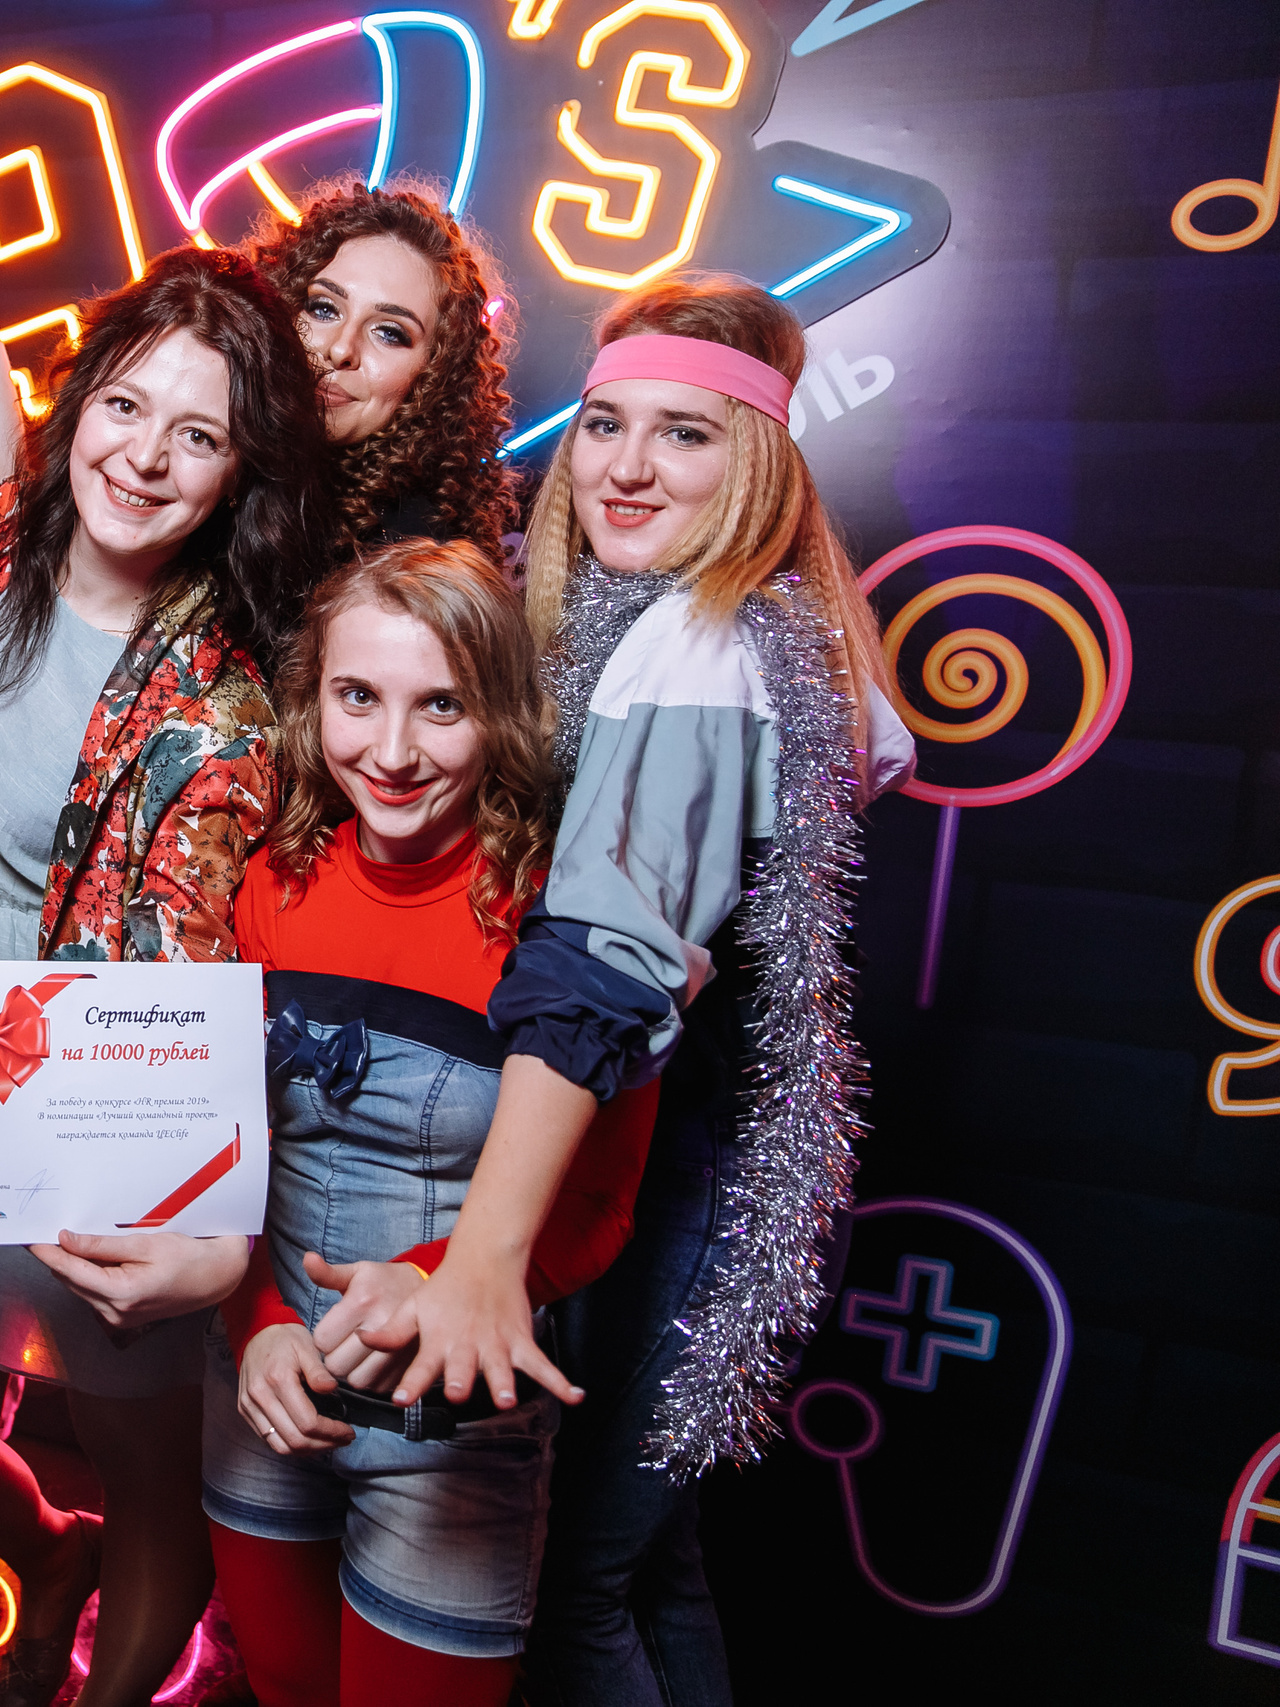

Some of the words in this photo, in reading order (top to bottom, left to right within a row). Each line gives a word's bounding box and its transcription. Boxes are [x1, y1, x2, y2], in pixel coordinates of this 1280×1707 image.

[85, 1004, 207, 1029] Сертификат
[61, 1046, 84, 1061] на
[90, 1044, 145, 1061] 10000
[147, 1041, 211, 1067] рублей
[46, 1098, 57, 1107] За
[59, 1097, 86, 1108] победу
[94, 1099, 132, 1109] конкурсе
[153, 1098, 185, 1108] премия
[37, 1112, 45, 1120] В
[46, 1113, 94, 1122] номинации
[135, 1110, 183, 1120] командный
[56, 1130, 116, 1141] награждается
[118, 1129, 154, 1139] команда
